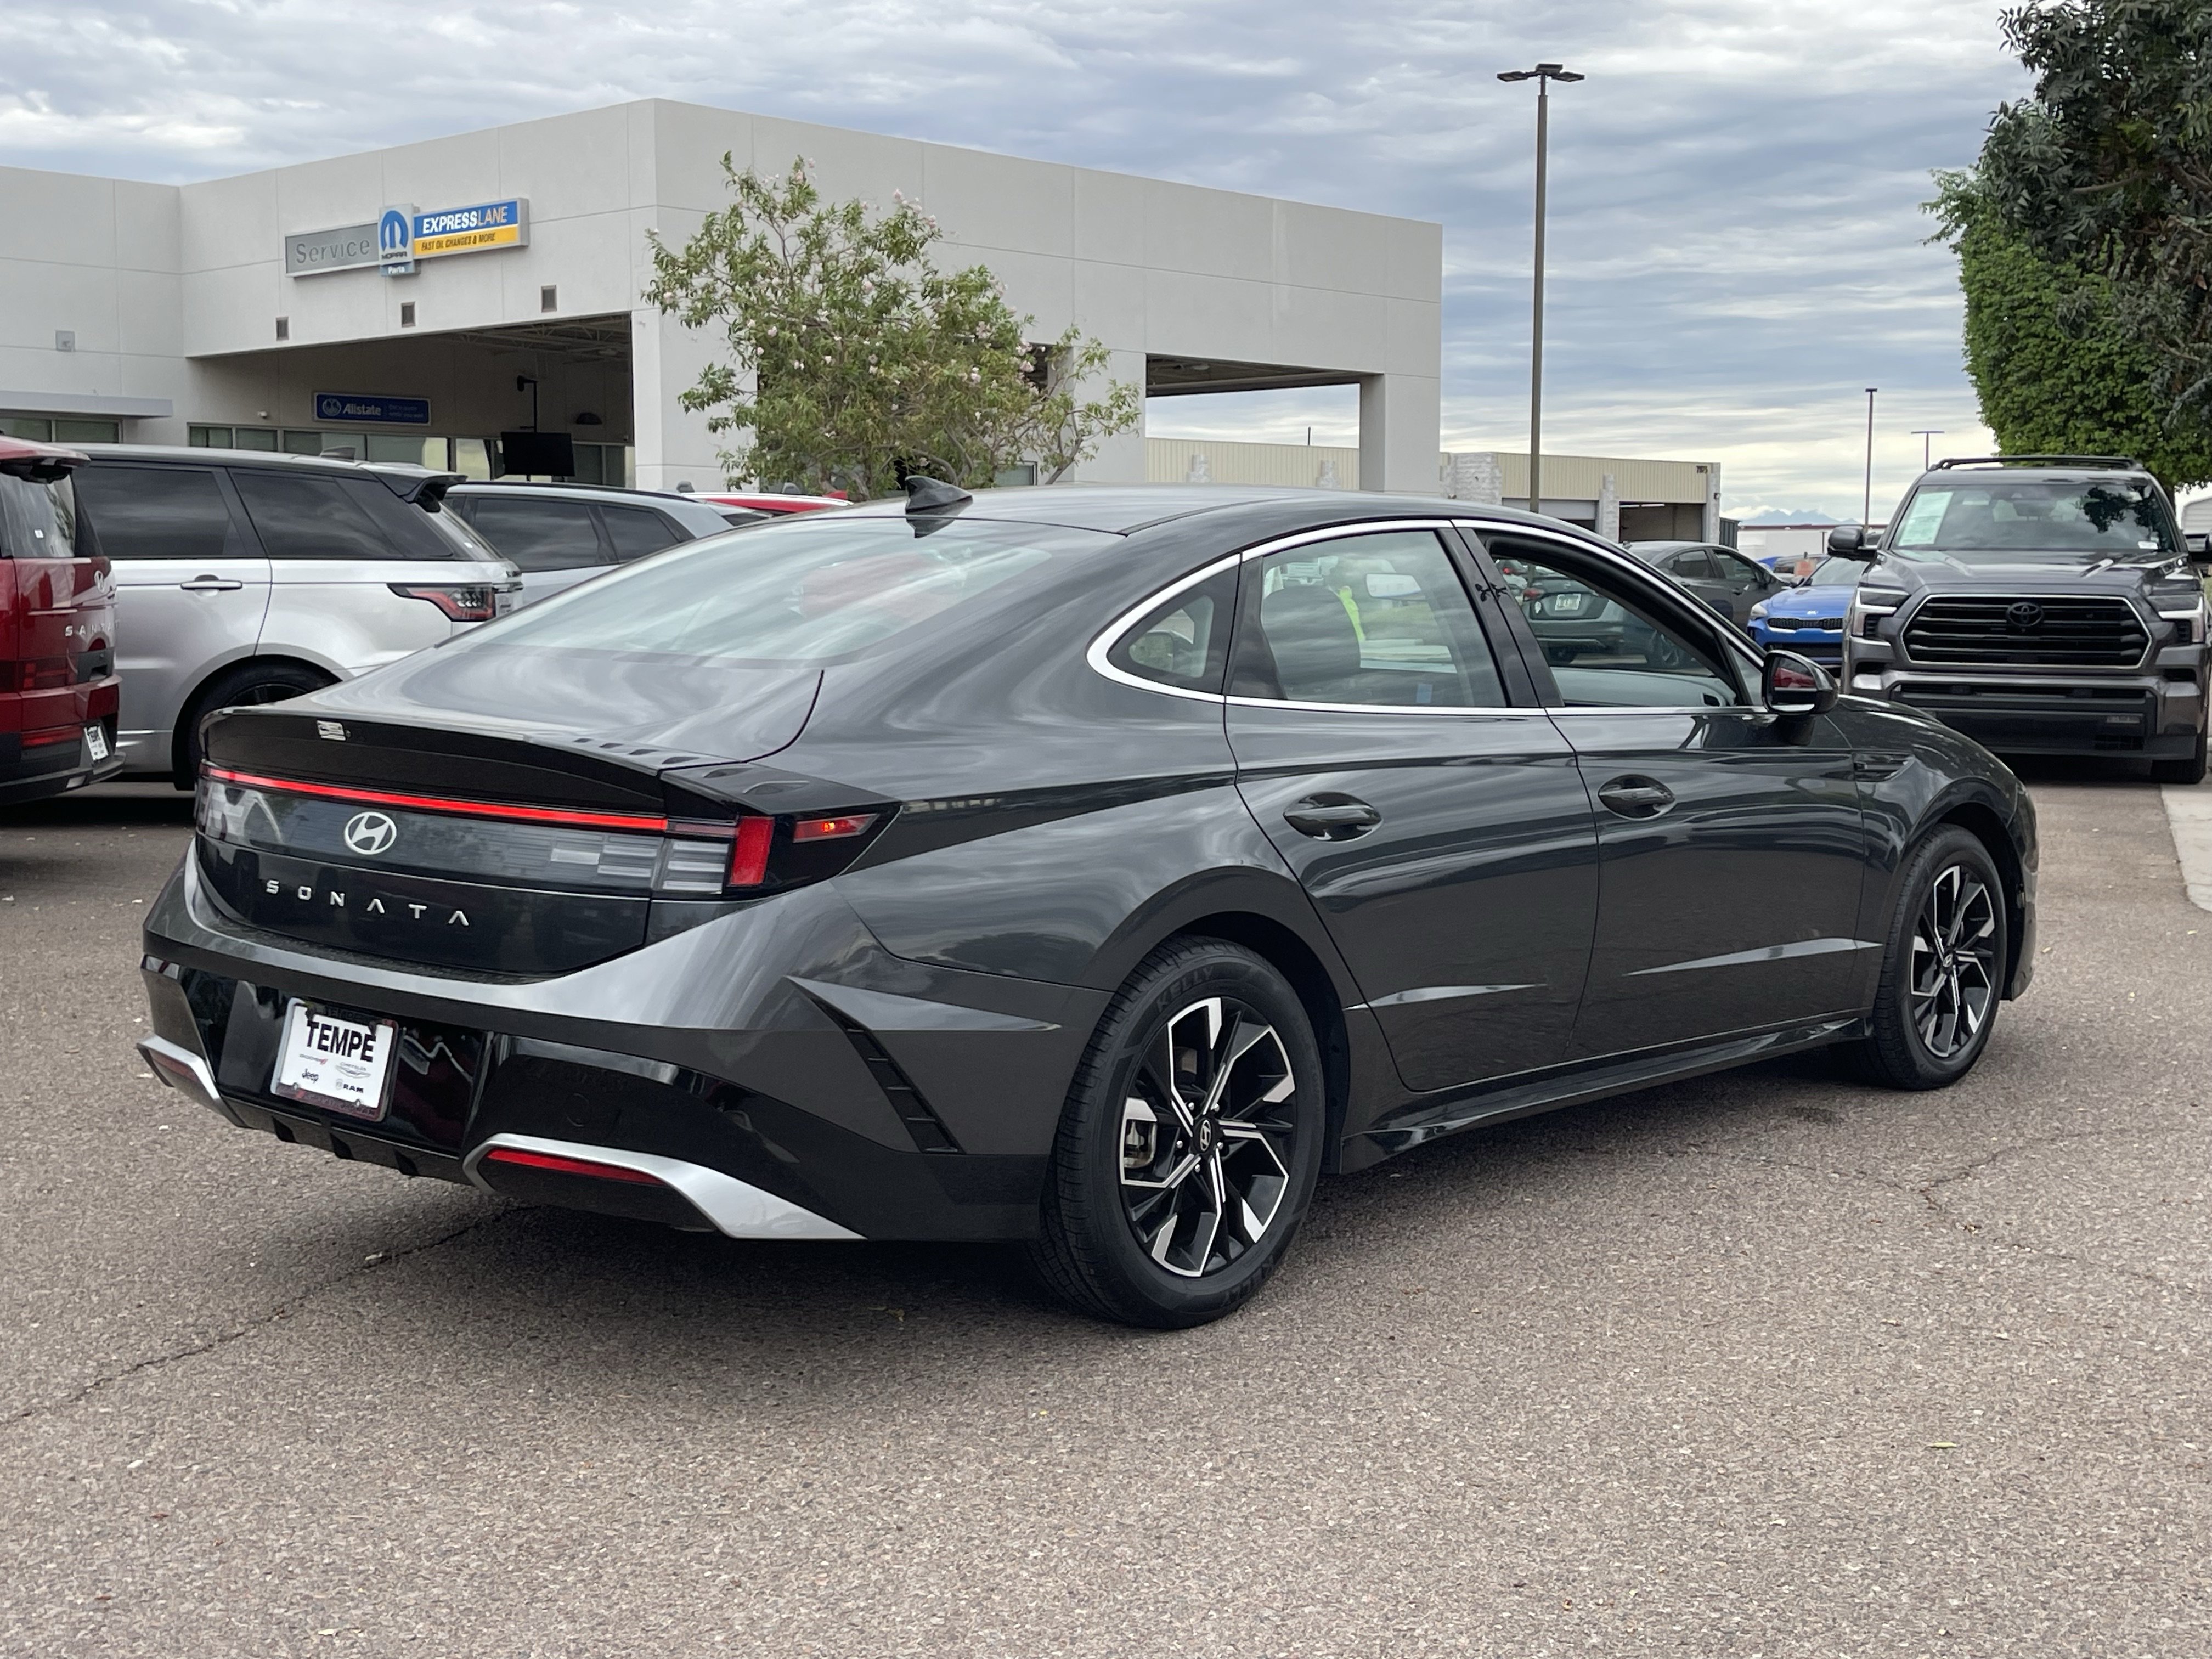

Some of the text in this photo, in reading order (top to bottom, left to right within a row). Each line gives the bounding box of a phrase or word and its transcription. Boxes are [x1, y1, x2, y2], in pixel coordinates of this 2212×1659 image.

[296, 238, 370, 263] Service
[421, 233, 495, 251] FAST OIL CHANGES & MORE
[343, 403, 381, 416] Allstate
[266, 879, 469, 927] SONATA
[306, 1020, 376, 1063] TEMPE
[302, 1068, 319, 1084] Jeep
[343, 1084, 364, 1093] RAM
